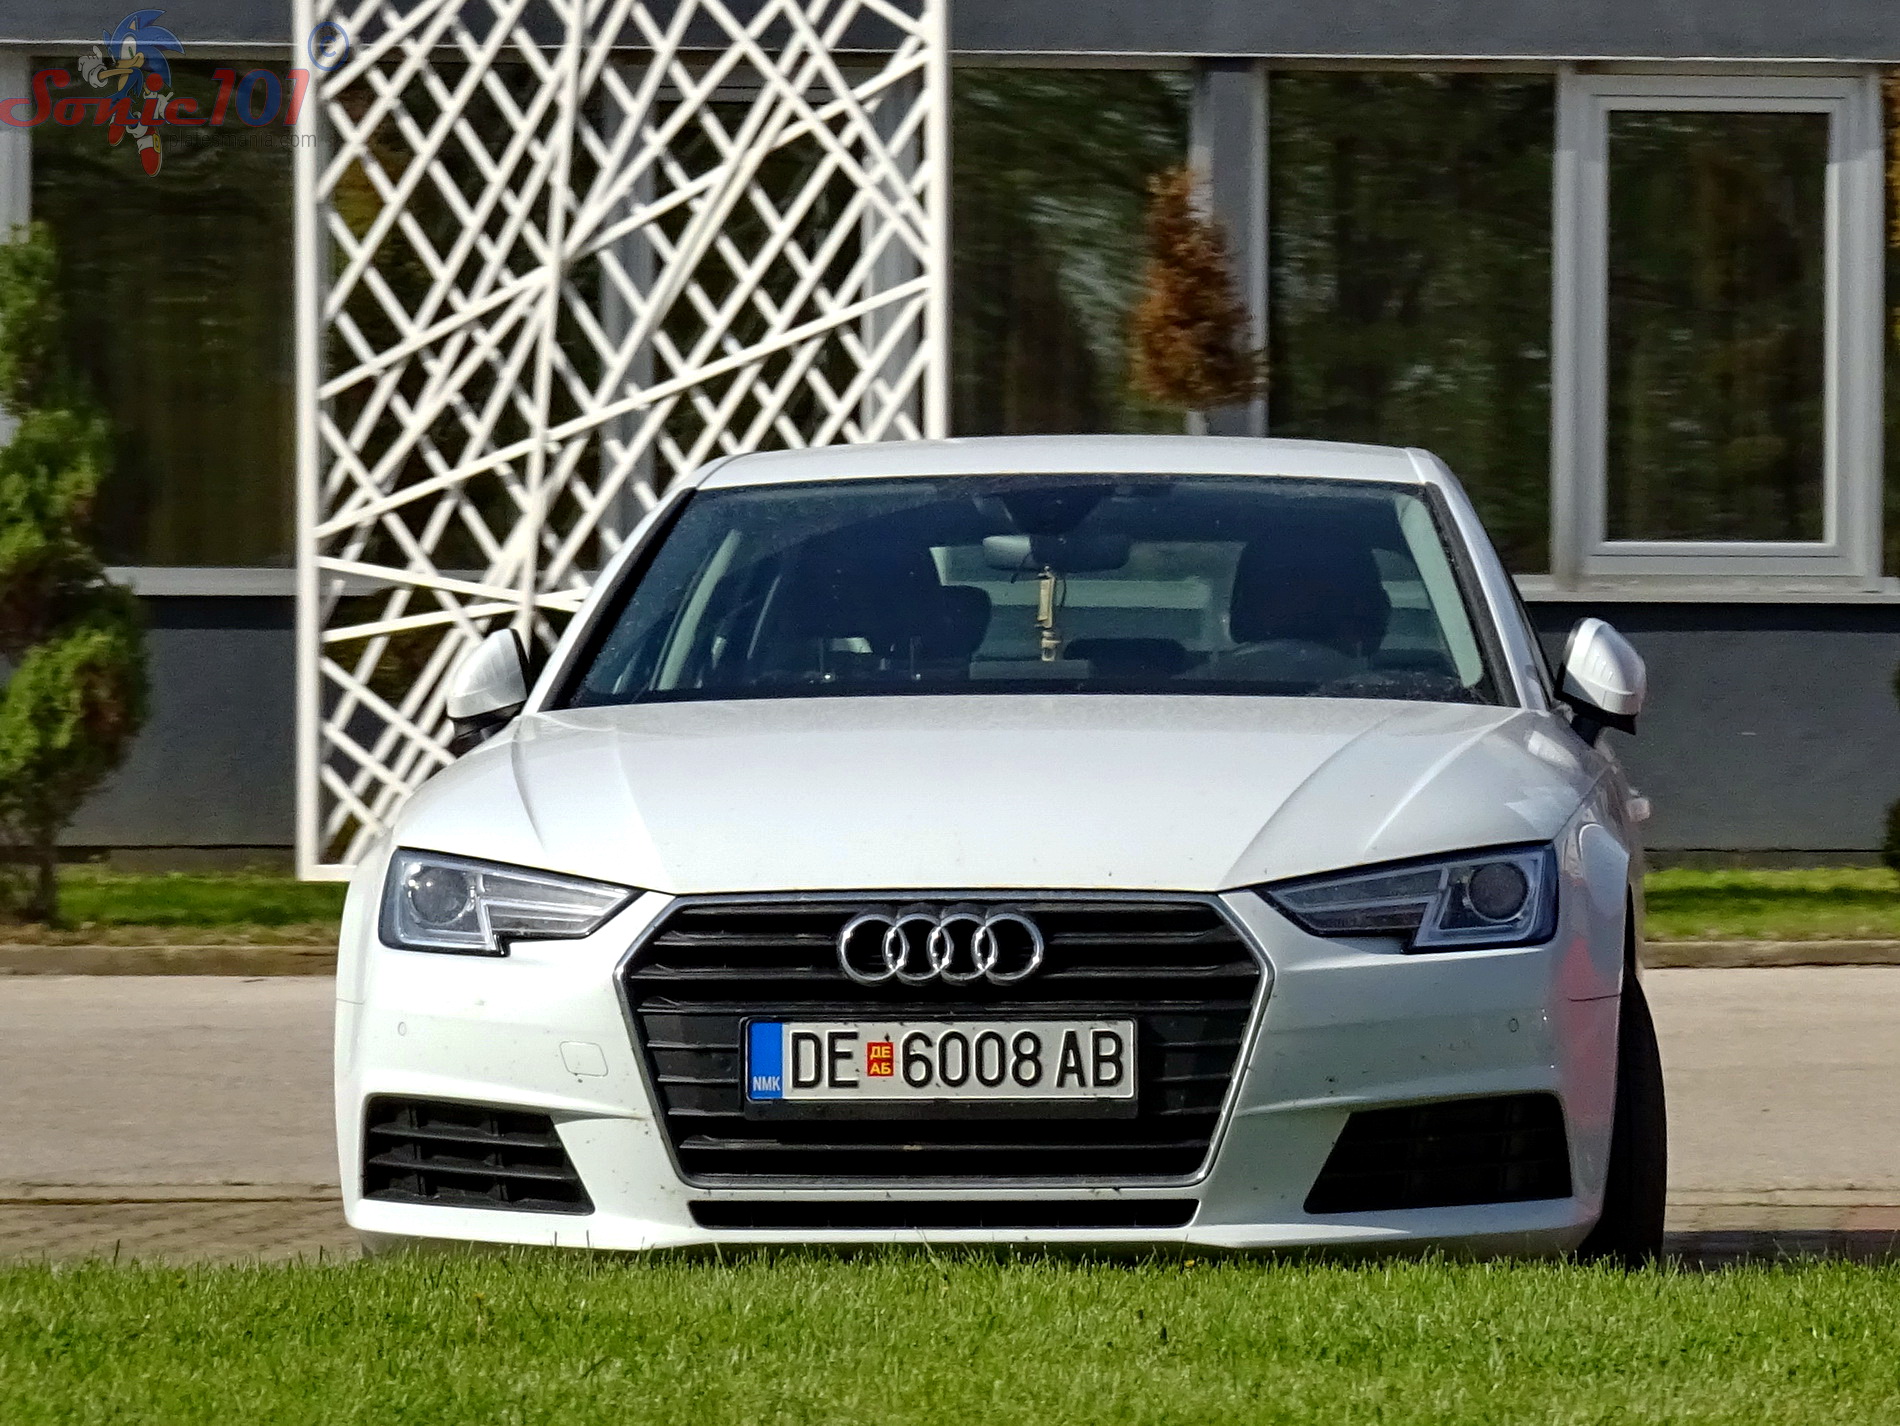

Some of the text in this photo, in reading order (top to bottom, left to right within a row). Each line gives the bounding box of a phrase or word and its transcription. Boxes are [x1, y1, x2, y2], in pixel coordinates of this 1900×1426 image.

[791, 1030, 1123, 1088] DE 6008 AB
[870, 1045, 891, 1060] ДЕ
[870, 1062, 891, 1075] АБ
[753, 1076, 781, 1092] NMK
